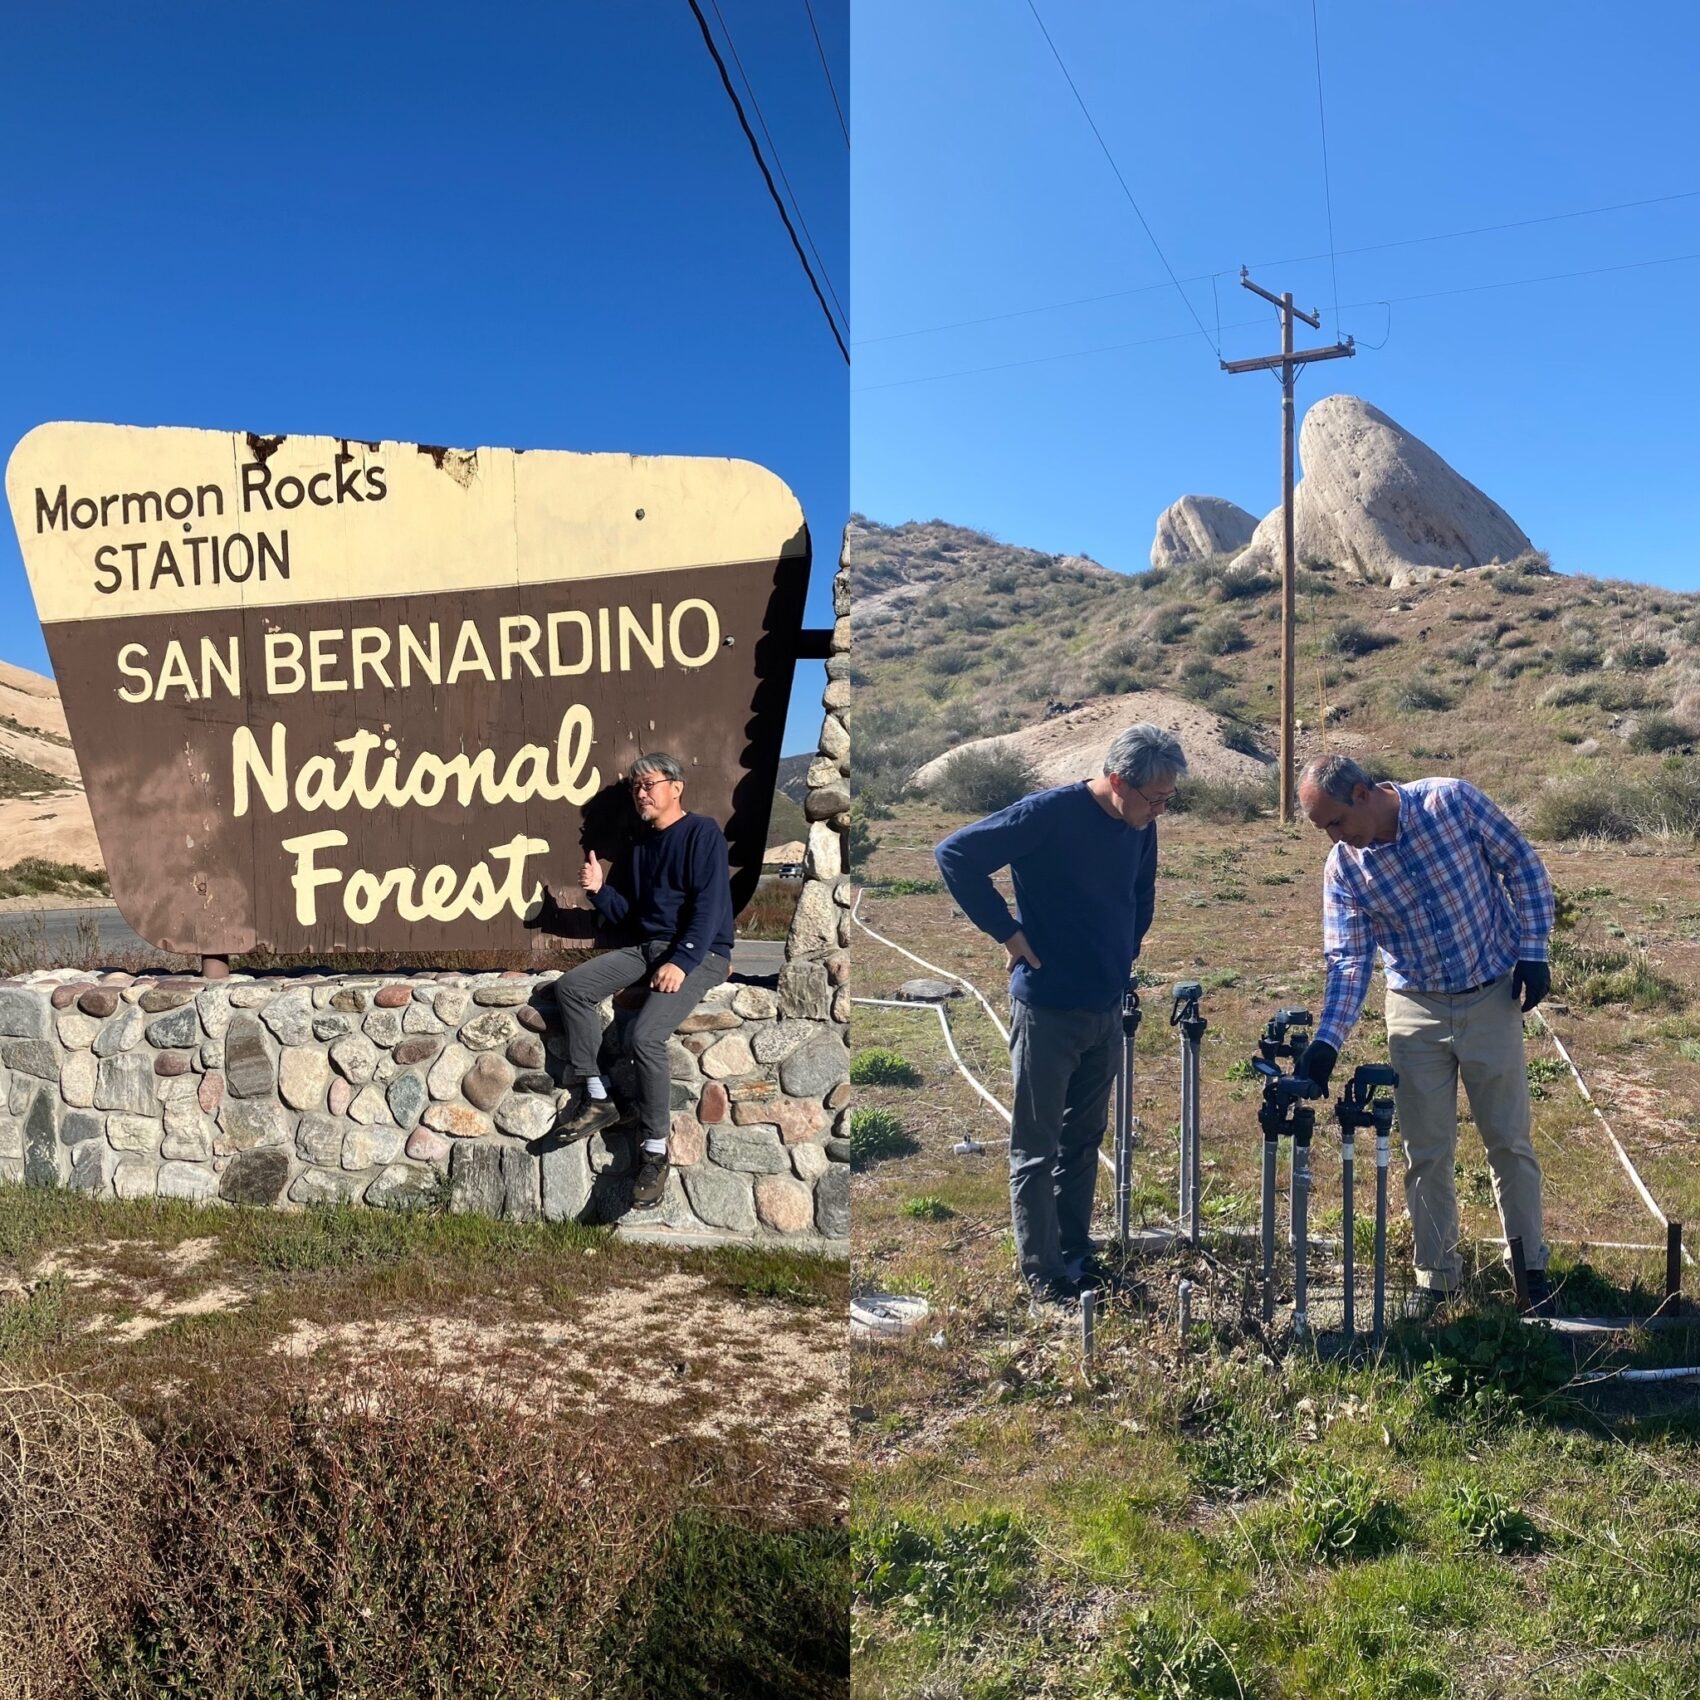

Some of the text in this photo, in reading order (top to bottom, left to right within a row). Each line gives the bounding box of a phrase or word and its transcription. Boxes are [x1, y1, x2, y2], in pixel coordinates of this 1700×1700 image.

[35, 454, 387, 534] Mormon Rocks
[94, 531, 290, 594] STATION
[117, 598, 720, 703] SAN BERNARDINO
[231, 703, 601, 817] National
[281, 829, 550, 926] Forest
